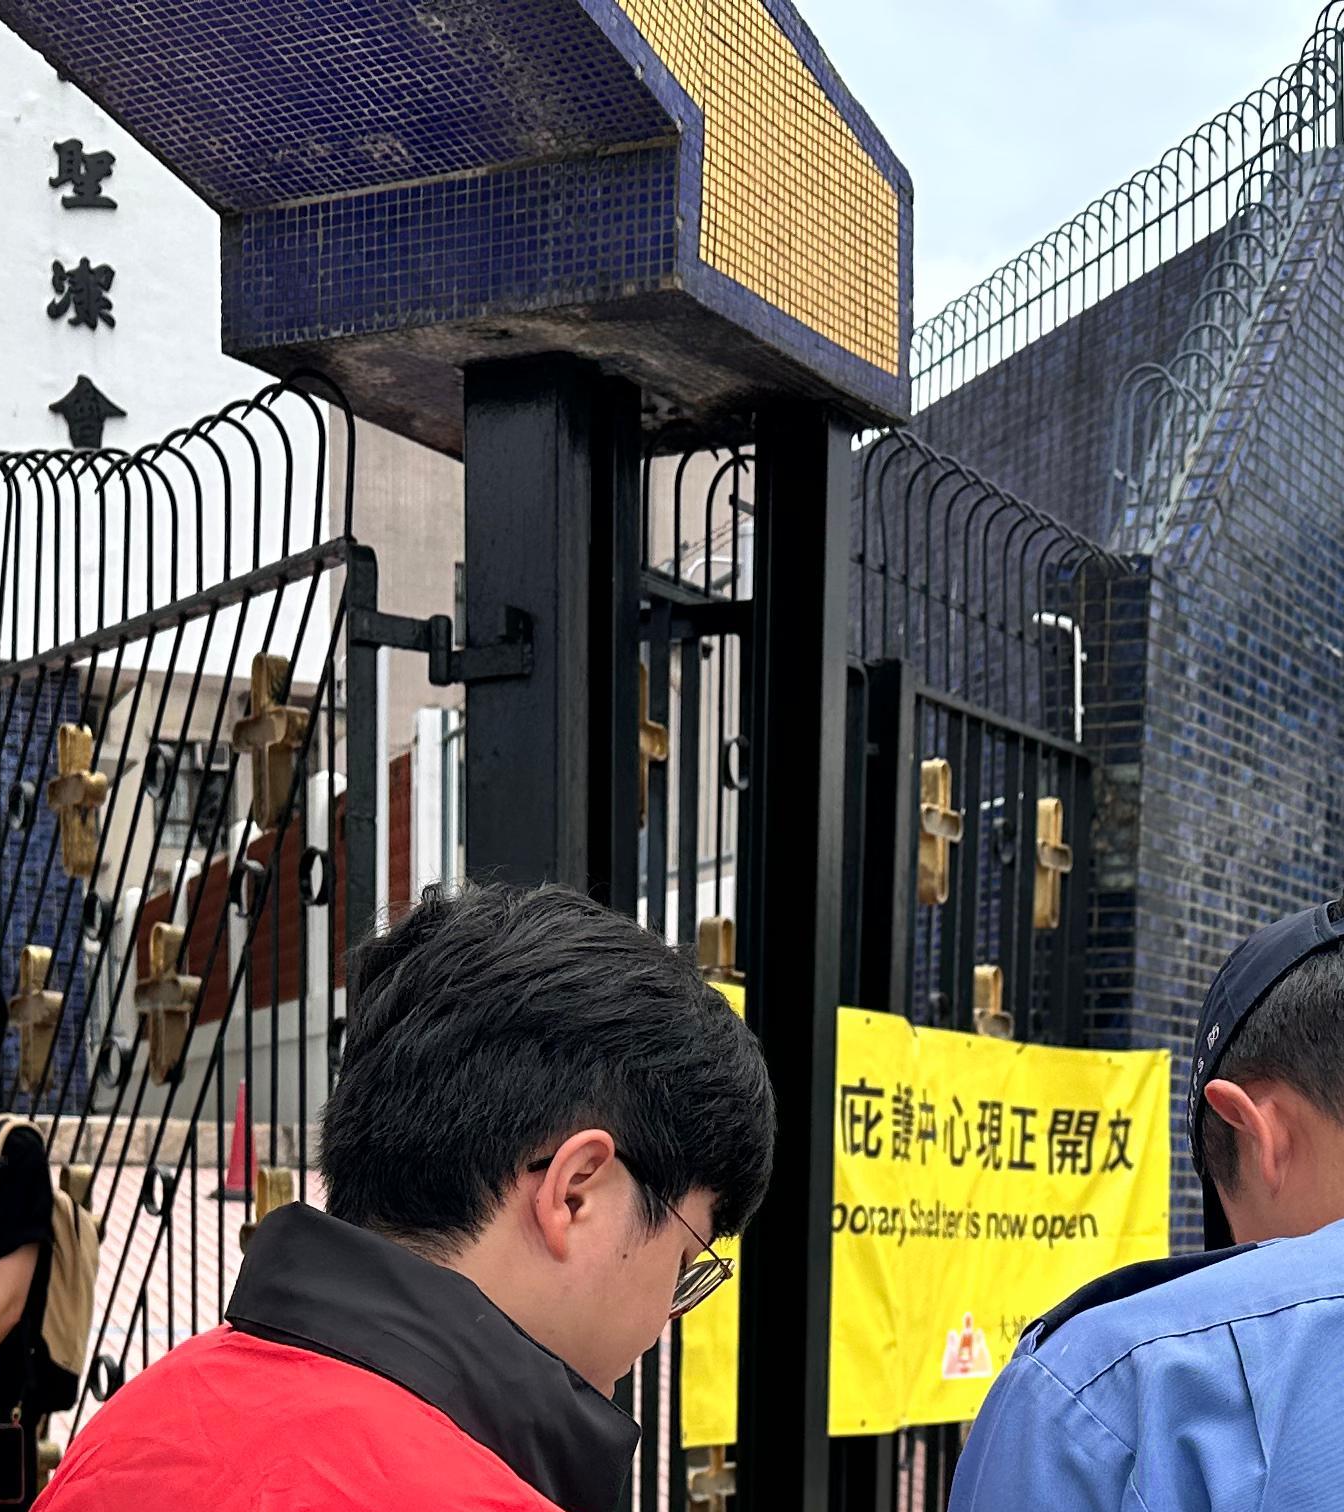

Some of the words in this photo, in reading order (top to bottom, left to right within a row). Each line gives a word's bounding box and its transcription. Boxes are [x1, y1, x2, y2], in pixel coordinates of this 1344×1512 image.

[966, 1200, 981, 1239] is
[986, 1211, 1027, 1240] now
[1032, 1211, 1099, 1250] open
